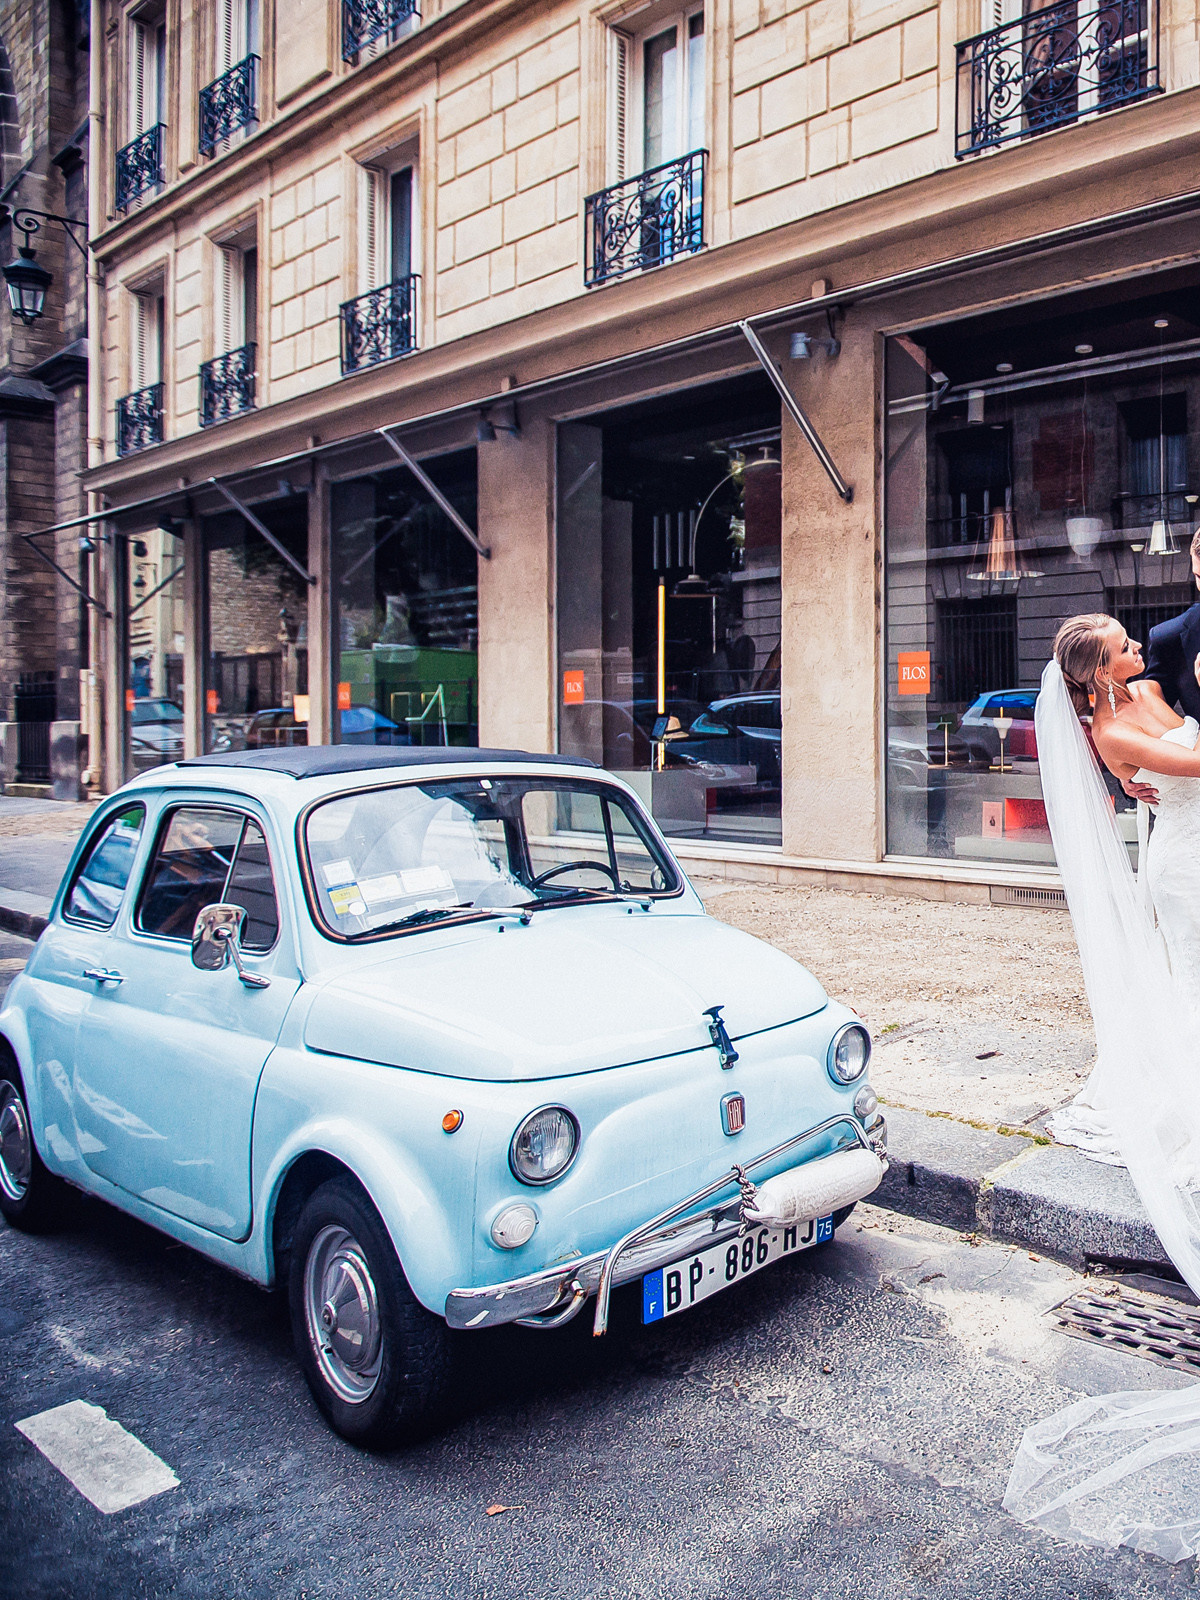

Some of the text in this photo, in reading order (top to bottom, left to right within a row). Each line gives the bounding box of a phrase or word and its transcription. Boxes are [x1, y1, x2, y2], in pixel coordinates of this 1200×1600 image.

[902, 666, 927, 680] FLOS
[727, 1100, 742, 1130] FIAT
[649, 1301, 657, 1315] F
[818, 1220, 832, 1238] 75
